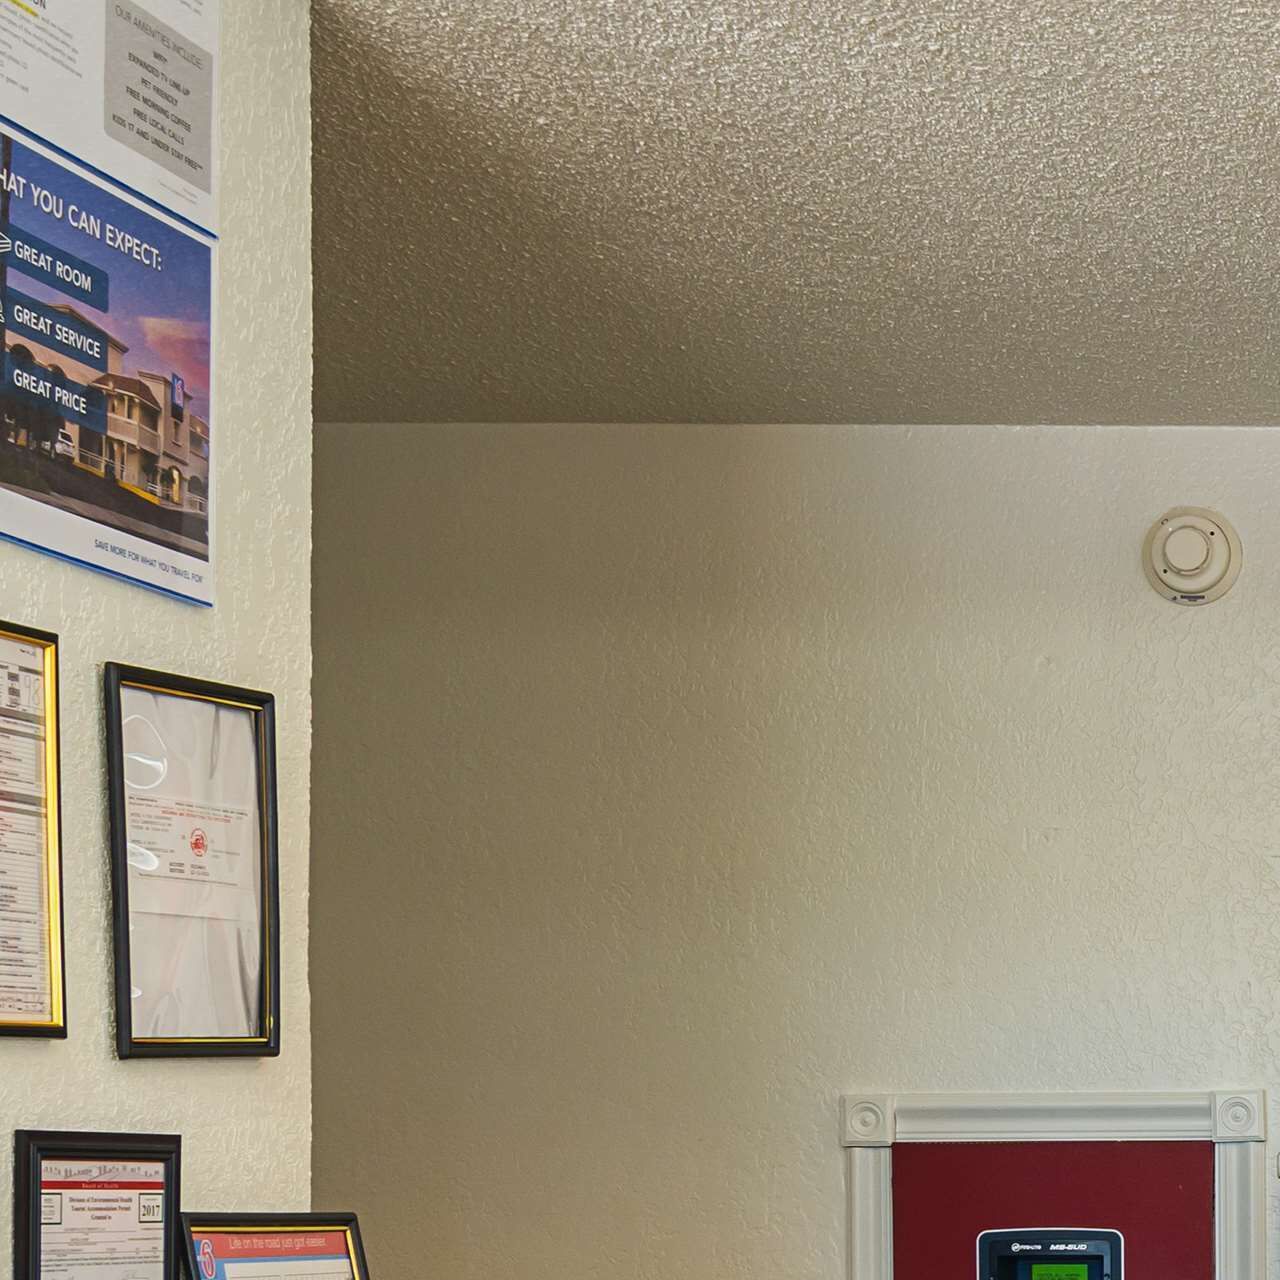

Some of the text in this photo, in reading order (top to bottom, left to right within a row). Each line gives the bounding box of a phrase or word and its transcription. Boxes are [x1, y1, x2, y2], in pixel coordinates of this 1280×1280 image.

[0, 168, 163, 271] HAT YOU CAN EXPECT:
[14, 241, 92, 292] GREAT ROOM
[14, 305, 101, 358] GREAT SERVICE
[13, 369, 87, 414] GREAT PRICE
[110, 544, 127, 558] MORE
[142, 1204, 160, 1217] 2017
[200, 1239, 216, 1280] 6
